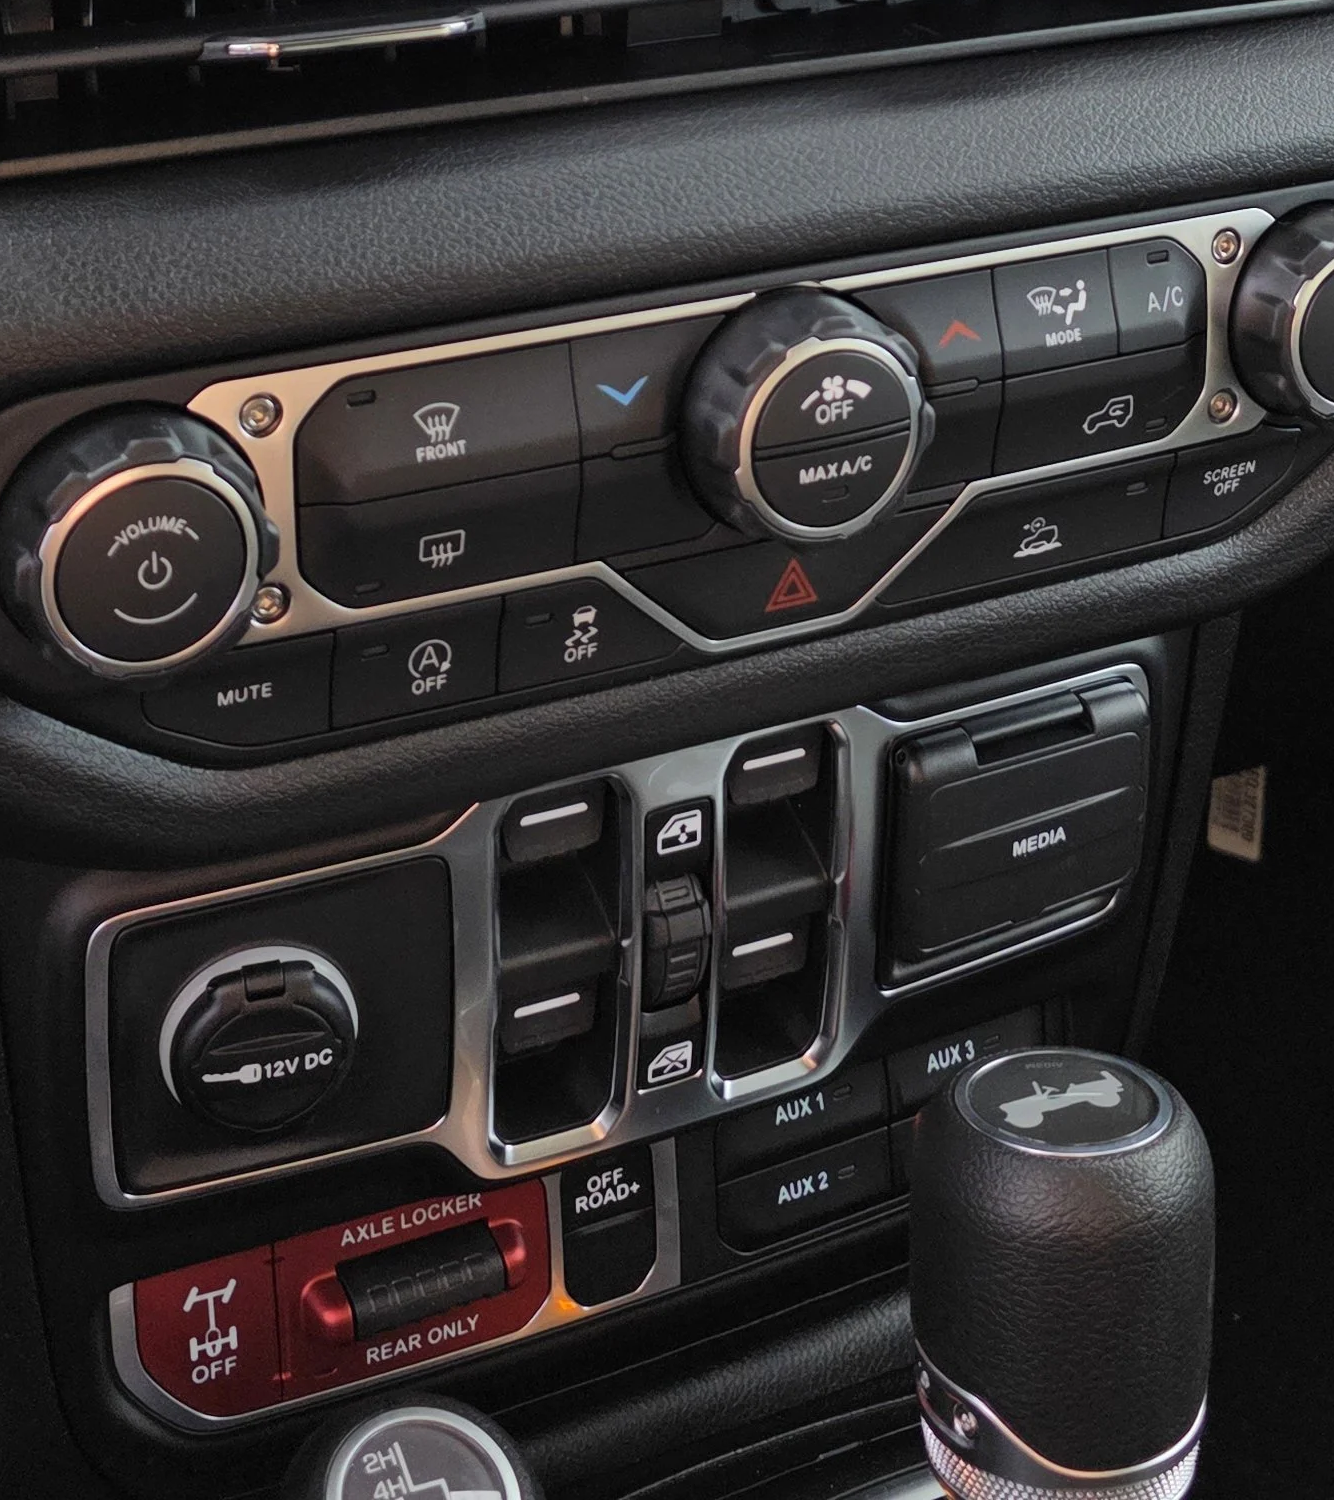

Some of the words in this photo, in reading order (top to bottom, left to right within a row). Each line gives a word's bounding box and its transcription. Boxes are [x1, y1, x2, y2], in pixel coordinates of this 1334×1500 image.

[1147, 285, 1184, 313] A/C
[1045, 327, 1082, 347] MODE
[815, 395, 855, 425] OFF
[415, 437, 467, 463] FRONT
[799, 462, 839, 485] MAX
[839, 455, 872, 477] A/C
[1203, 459, 1257, 485] SCREEN
[1214, 475, 1240, 497] OFF
[115, 516, 188, 547] VOLUME
[563, 641, 598, 663] OFF
[217, 682, 273, 707] MUTE
[410, 673, 448, 696] OFF
[1011, 825, 1067, 858] MEDIA
[264, 1055, 300, 1080] 12V
[304, 1047, 333, 1070] DC
[927, 1043, 962, 1074] AUX
[964, 1039, 975, 1061] 3
[775, 1097, 813, 1126] AUX
[815, 1091, 825, 1111] 1
[586, 1167, 624, 1192] OFF
[777, 1179, 815, 1205] AUX
[817, 1171, 829, 1191] 2
[575, 1178, 641, 1214] ROAD+
[340, 1216, 395, 1247] AXLE
[400, 1192, 483, 1230] LOCKER
[366, 1336, 419, 1364] REAR
[428, 1314, 480, 1348] ONLY
[191, 1356, 238, 1385] OFF
[363, 1448, 398, 1474] 2H
[373, 1475, 407, 1500] 4H
